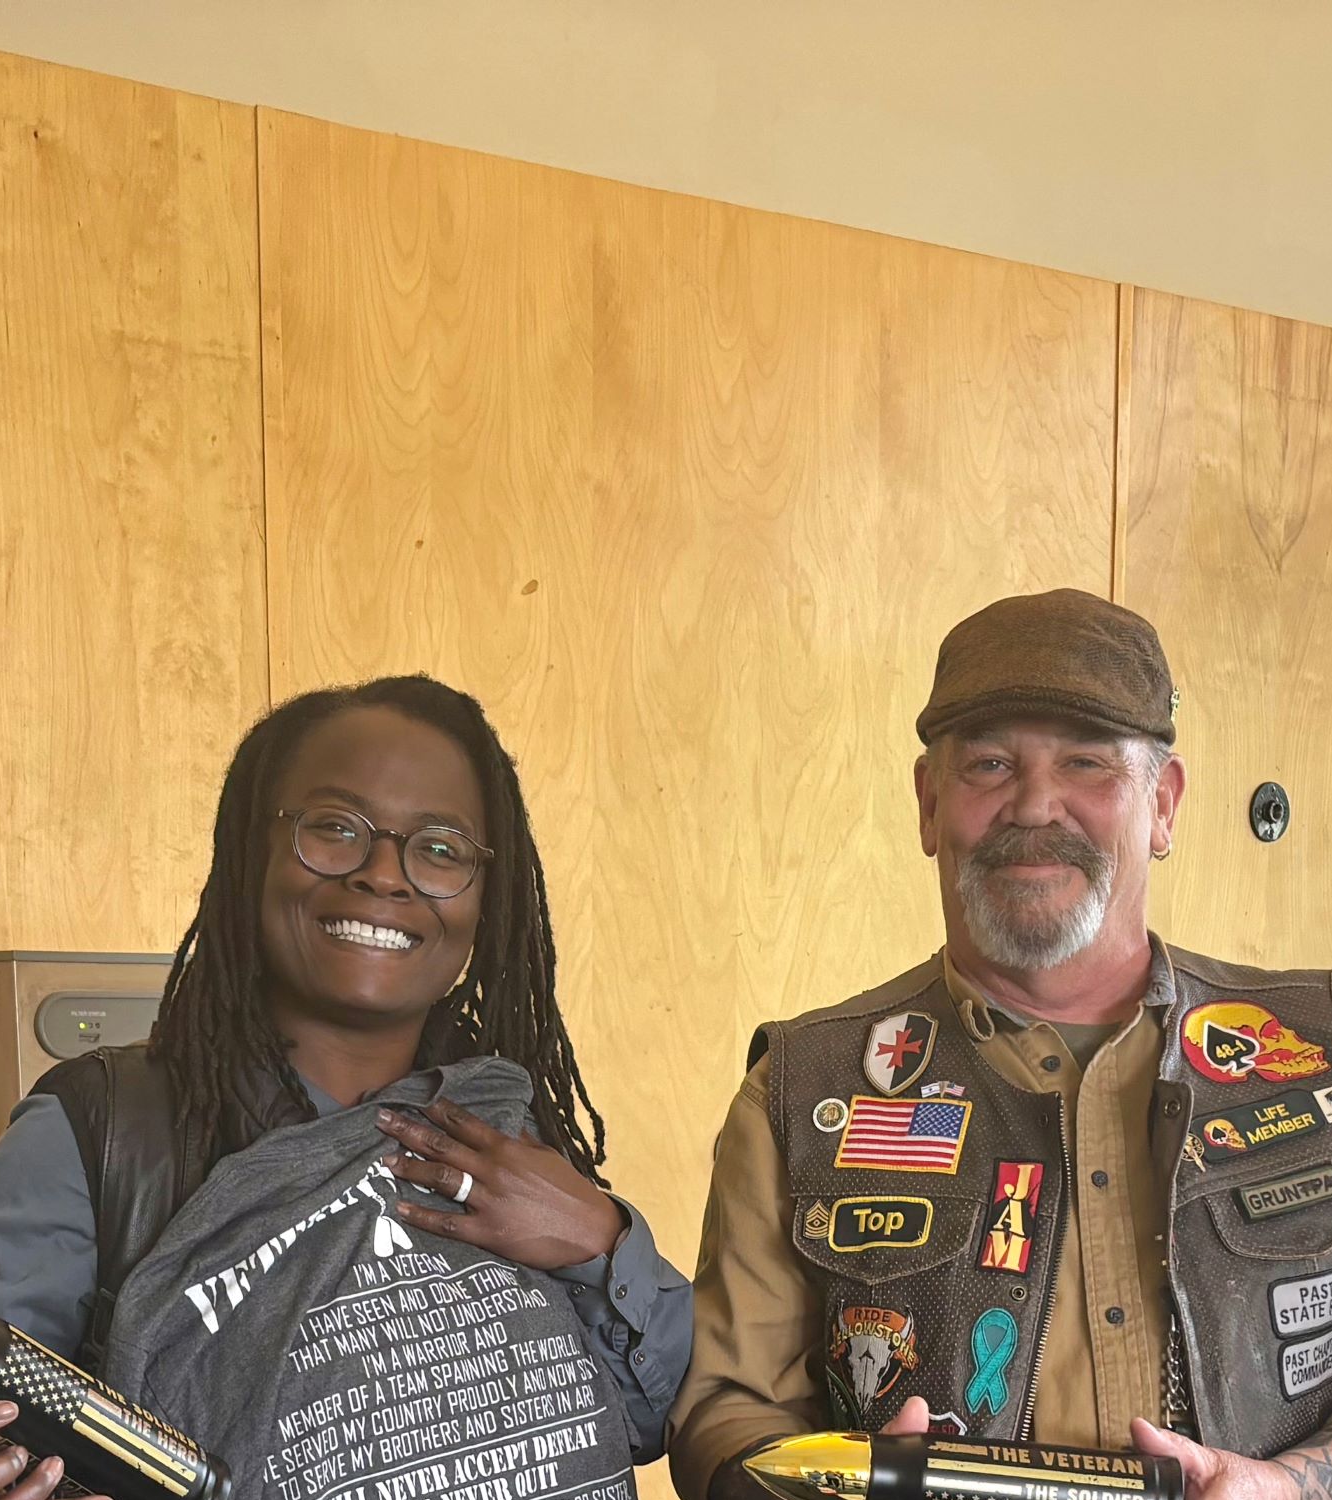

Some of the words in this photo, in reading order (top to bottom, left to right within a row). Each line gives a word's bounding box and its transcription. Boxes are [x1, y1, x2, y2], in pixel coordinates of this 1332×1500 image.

[1215, 1039, 1247, 1059] 48-1
[1246, 1112, 1315, 1145] MEMBER
[1254, 1103, 1289, 1123] LIFE
[853, 1208, 904, 1236] Top
[981, 1164, 1035, 1271] JAM
[353, 1263, 377, 1288] I'M
[377, 1261, 391, 1283] A
[289, 1339, 332, 1373] THAT
[334, 1325, 379, 1356] MANY
[380, 1316, 418, 1342] WILL
[418, 1307, 450, 1336] NOT
[450, 1289, 550, 1327] UNDERSTAND.
[309, 1305, 353, 1337] HAVE
[352, 1294, 396, 1325] SEEN
[399, 1288, 428, 1313] AND
[429, 1280, 471, 1304] DONE
[854, 1309, 892, 1325] RIDE
[1280, 1303, 1325, 1325] STATE
[362, 1352, 387, 1378] I'M
[390, 1347, 402, 1371] A
[402, 1331, 471, 1367] WARRIOR
[474, 1321, 508, 1351] AND
[1285, 1349, 1310, 1372] PAST
[278, 1393, 344, 1443] MEMBER
[347, 1384, 369, 1413] OF
[375, 1381, 386, 1405] A
[387, 1370, 429, 1400] TEAM
[431, 1349, 509, 1389] SPANNING
[509, 1340, 538, 1367] THE
[537, 1334, 581, 1362] WORLD.
[94, 1378, 127, 1406] THE
[132, 1403, 199, 1450] SOLDIER
[122, 1408, 152, 1438] THE
[157, 1431, 198, 1467] HERO
[281, 1426, 339, 1474] SERVED
[342, 1416, 366, 1445] MY
[371, 1394, 442, 1436] COUNTRY
[447, 1374, 518, 1415] PROUDLY
[523, 1368, 547, 1395] AND
[546, 1362, 577, 1389] NOW
[303, 1452, 348, 1495] SERVE
[351, 1443, 373, 1471] MY
[379, 1419, 461, 1464] BROTHERS
[466, 1410, 497, 1440] AND
[500, 1393, 556, 1429] SISTERS
[556, 1389, 574, 1414] IN
[454, 1440, 528, 1486] ACCEPT
[531, 1420, 598, 1462] DEFEAT
[987, 1446, 1031, 1464] THE
[1040, 1450, 1145, 1476] VETERAN
[514, 1461, 559, 1498] QUIT
